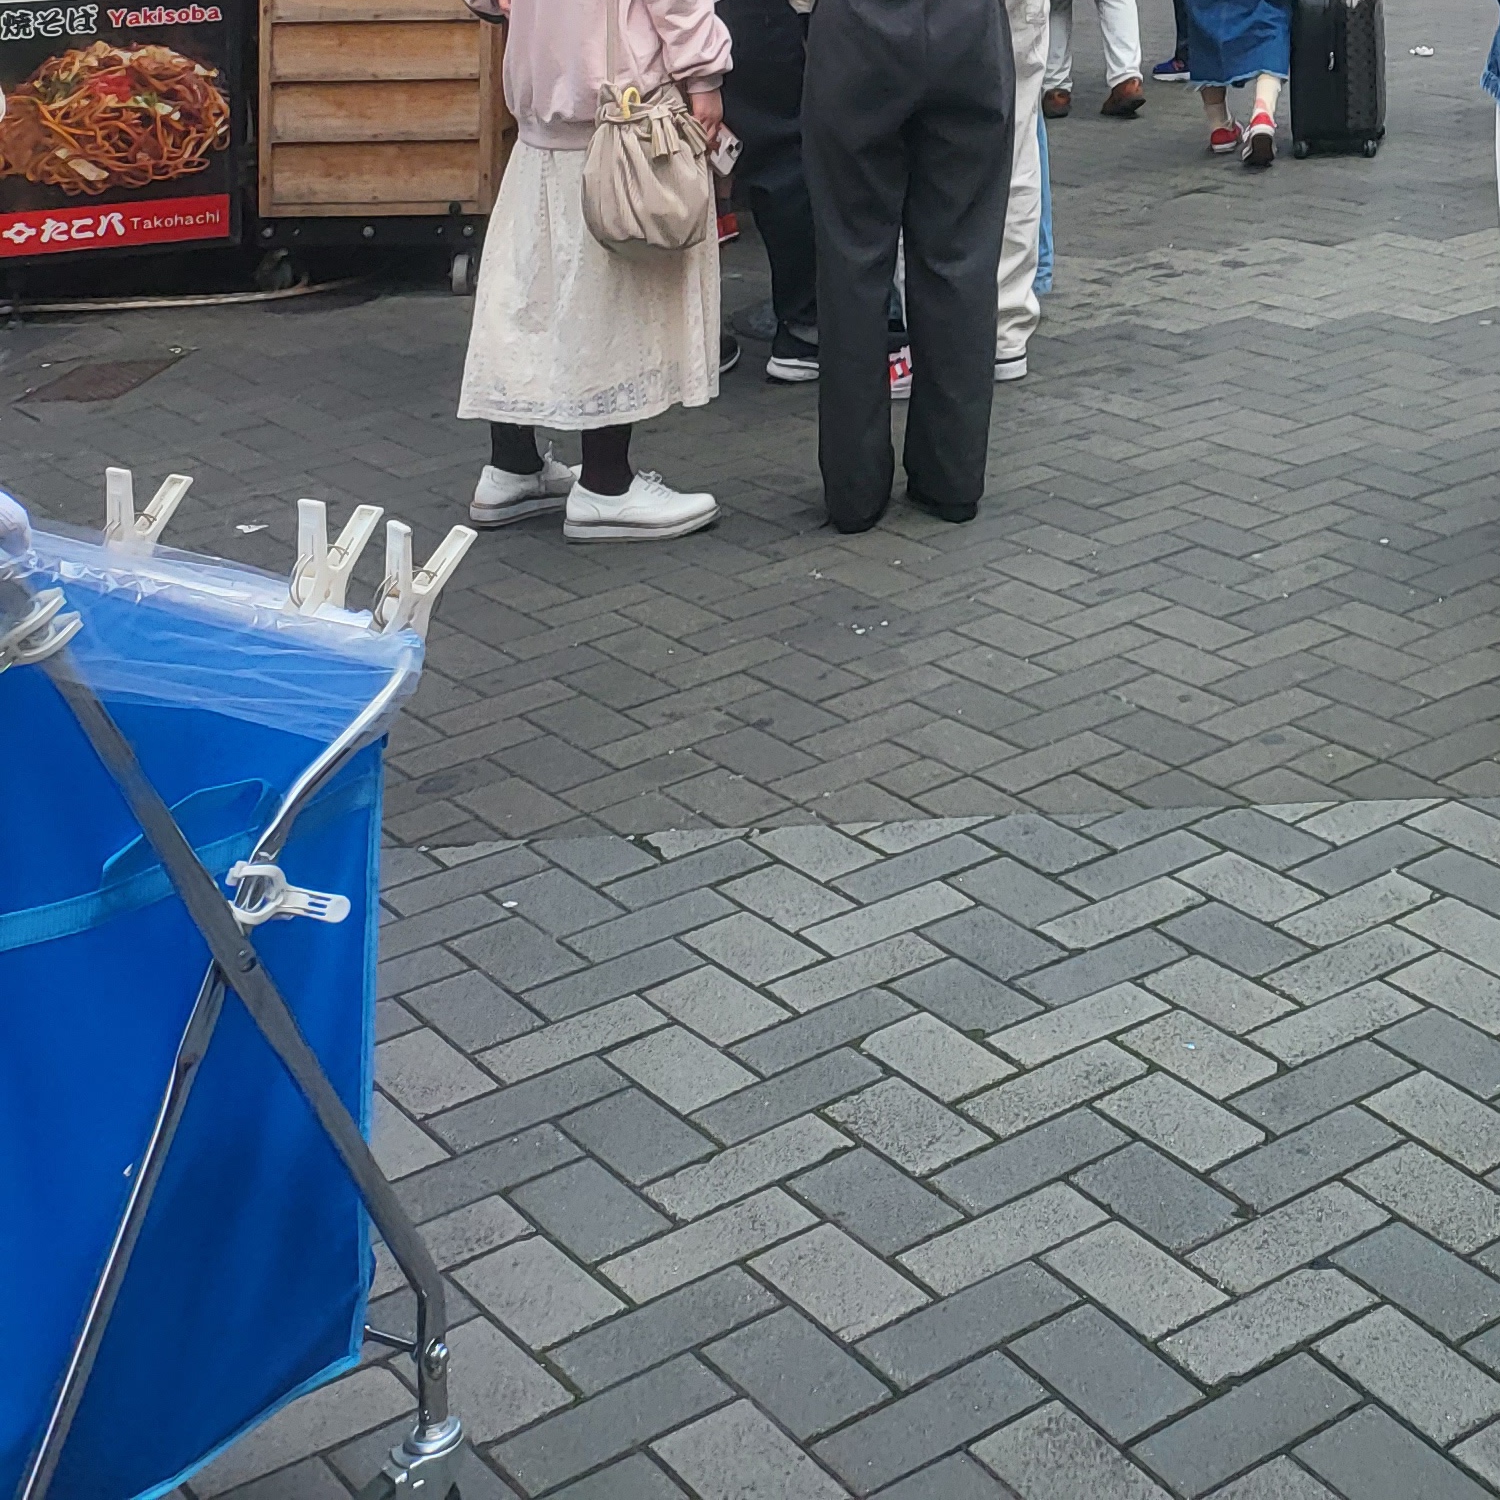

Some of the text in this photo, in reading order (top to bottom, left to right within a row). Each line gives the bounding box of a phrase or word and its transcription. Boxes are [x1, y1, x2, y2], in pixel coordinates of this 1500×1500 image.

[1, 4, 222, 40] 焼そば Yakisoba
[130, 209, 222, 231] Takohachi
